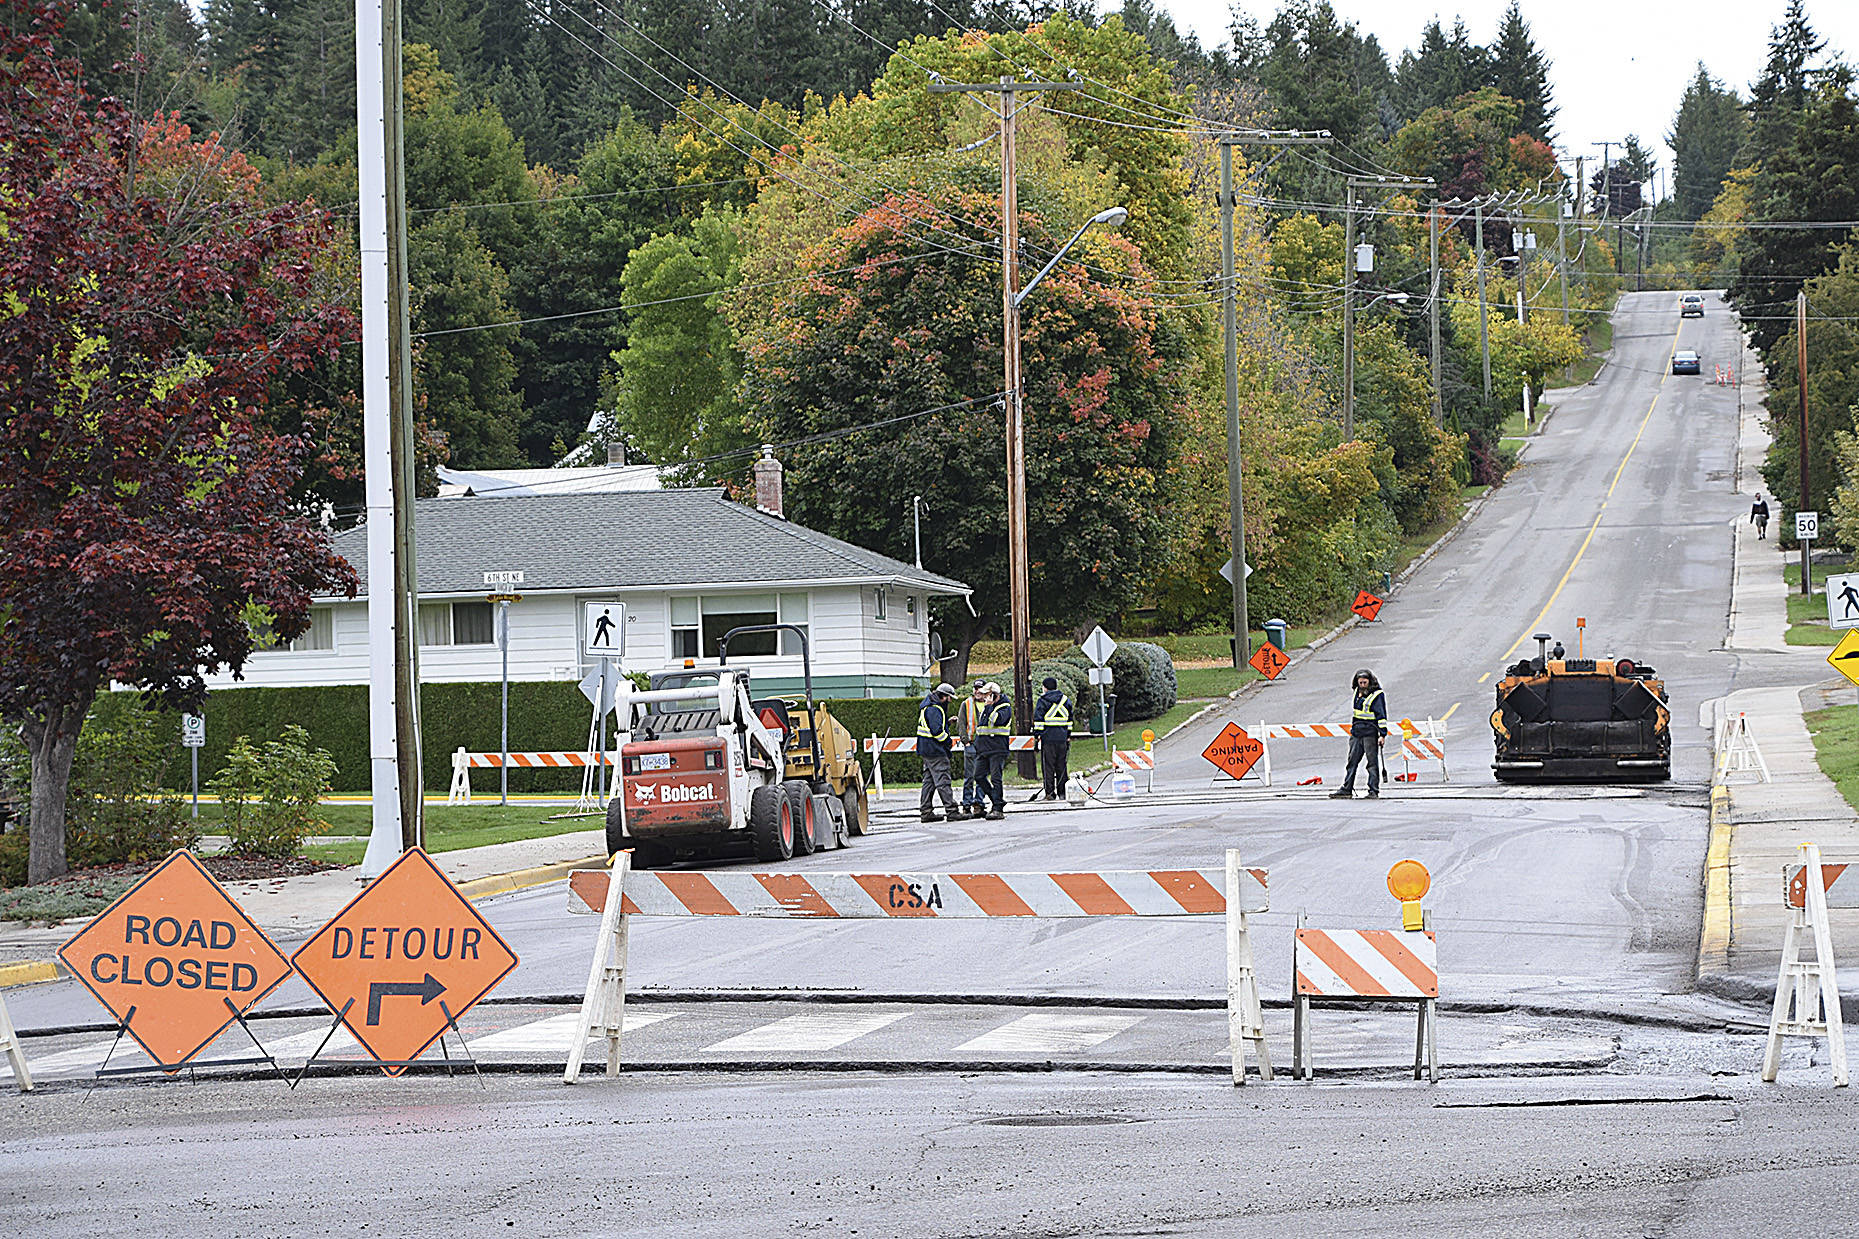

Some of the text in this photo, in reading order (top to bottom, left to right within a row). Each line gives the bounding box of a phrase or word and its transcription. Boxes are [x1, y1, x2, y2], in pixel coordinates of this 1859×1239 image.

[1799, 519, 1816, 532] 50
[487, 573, 500, 582] 6TH
[512, 572, 520, 581] NE
[628, 615, 637, 623] 20
[1211, 743, 1258, 757] PARKING
[1228, 755, 1244, 766] NO
[660, 782, 715, 803] Bobcat
[889, 883, 943, 909] CSA
[125, 914, 237, 950] ROAD
[331, 927, 482, 960] DETOUR
[90, 953, 258, 993] CLOSED
